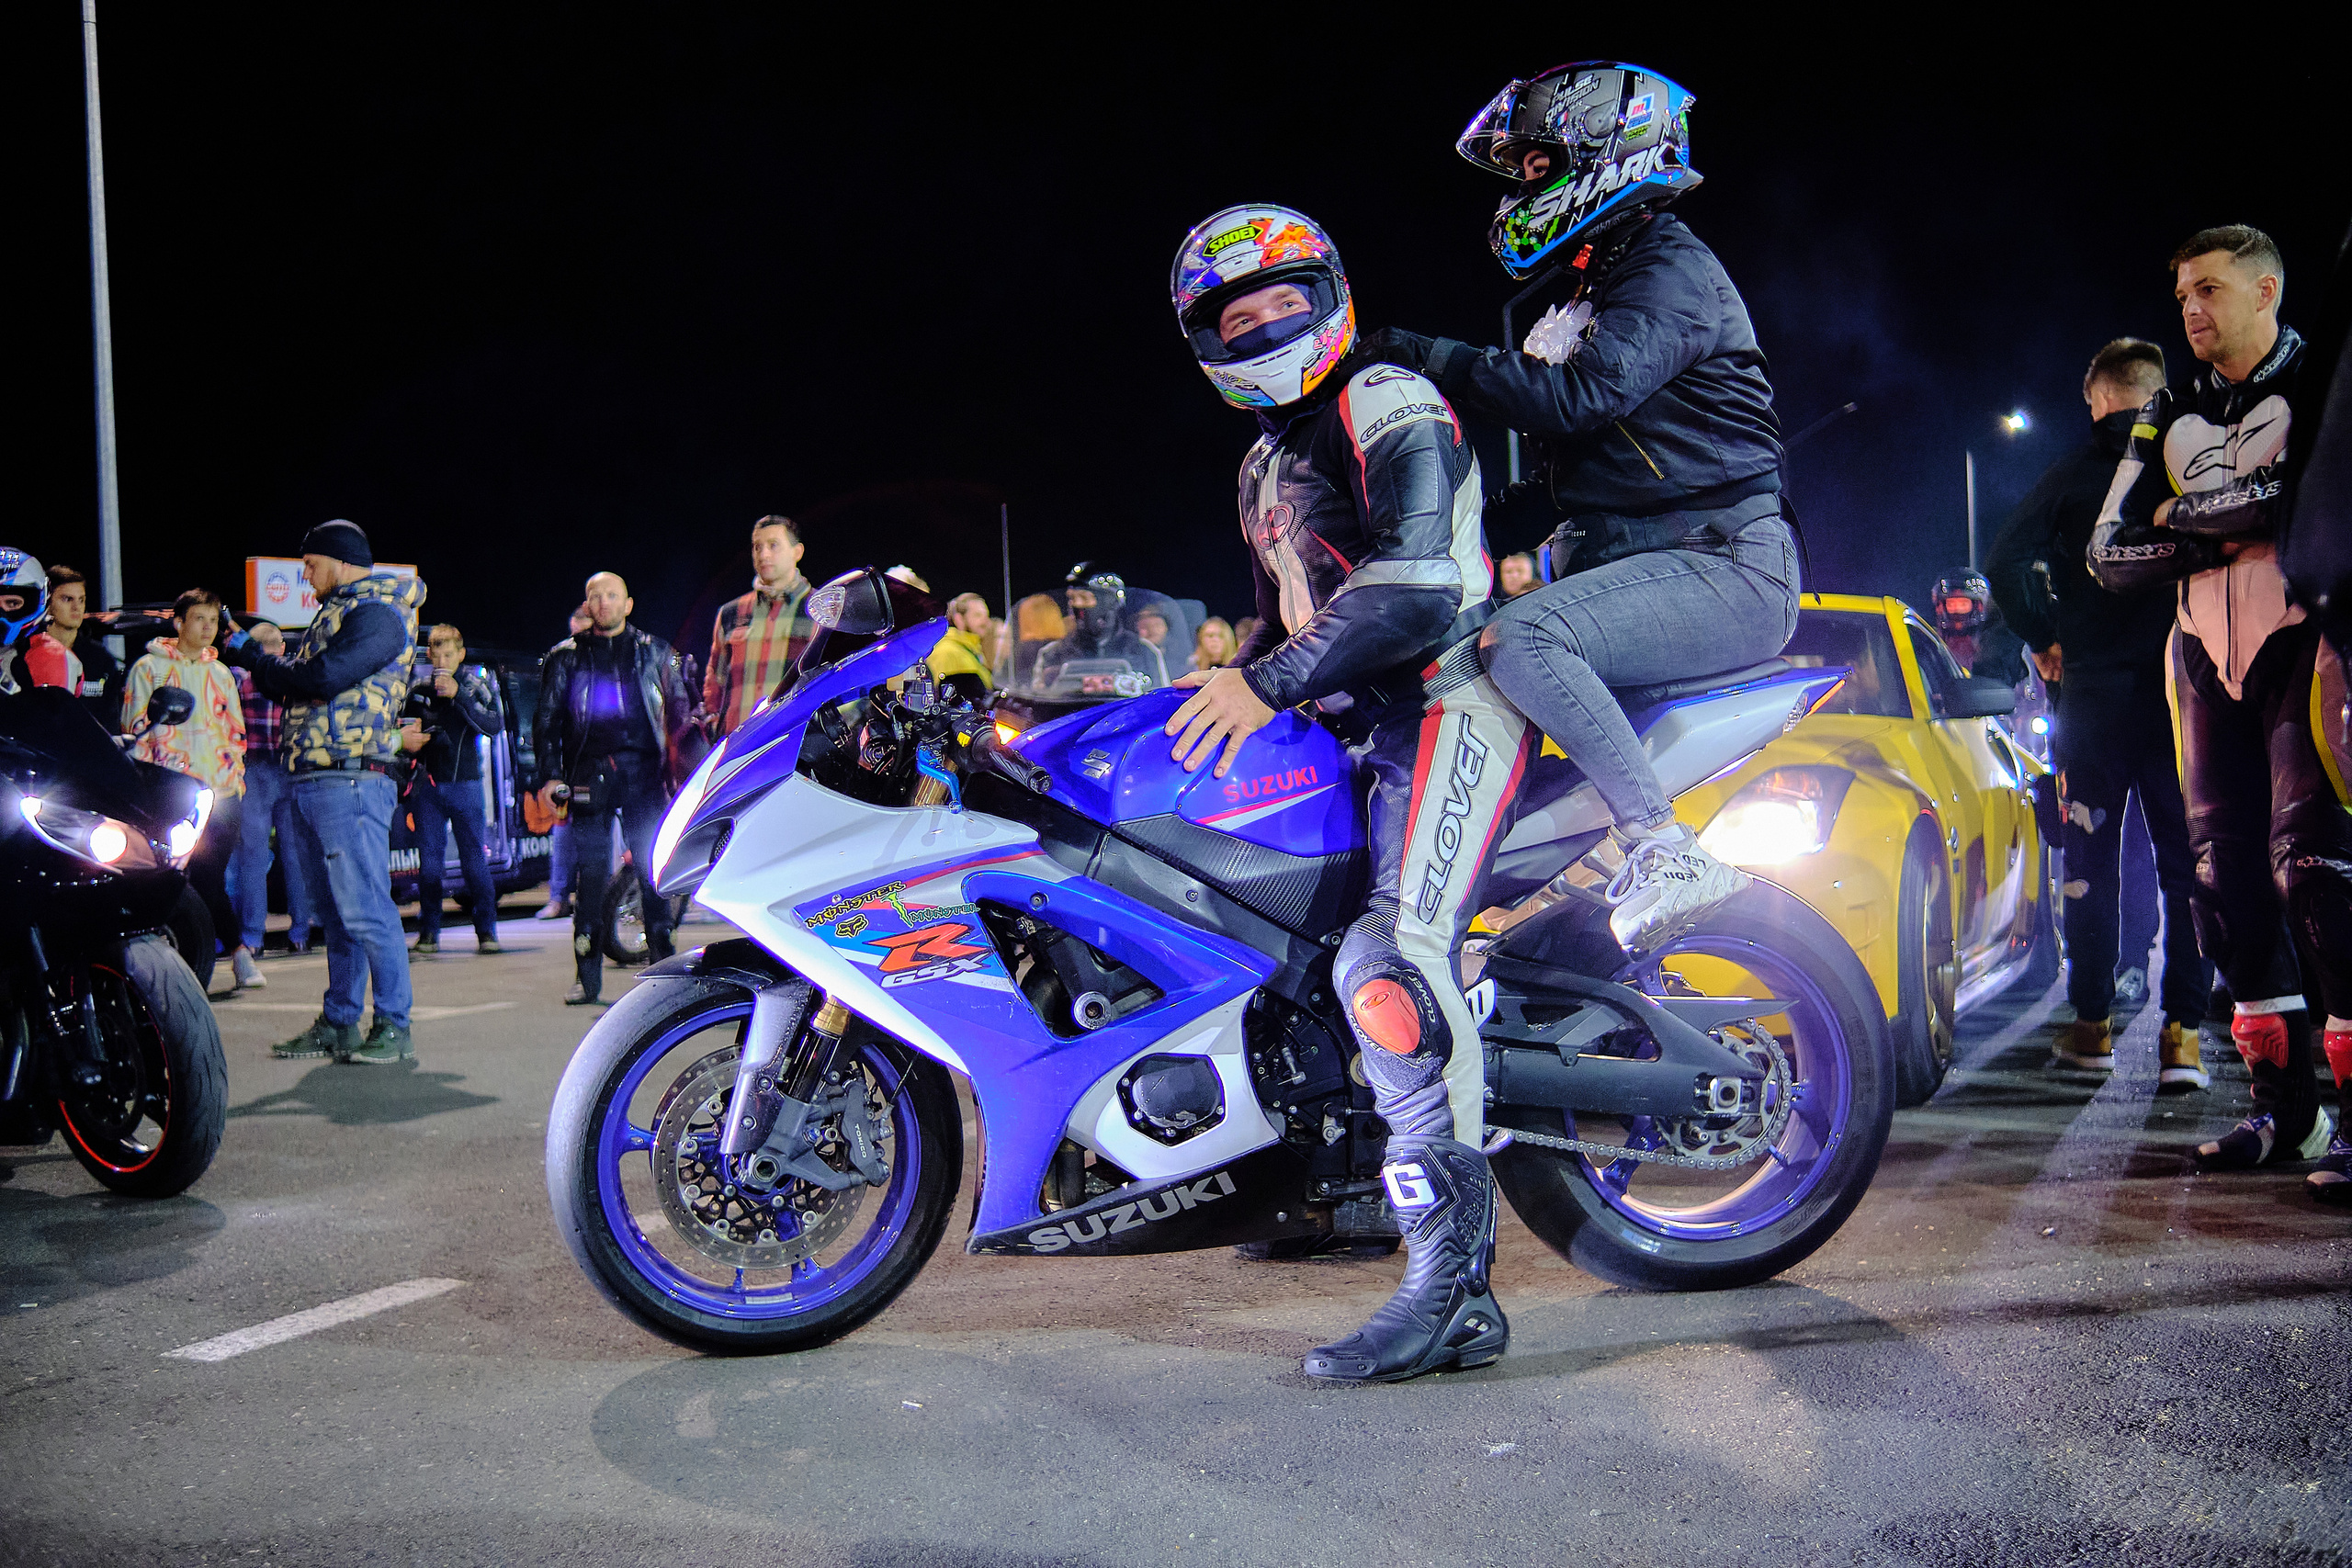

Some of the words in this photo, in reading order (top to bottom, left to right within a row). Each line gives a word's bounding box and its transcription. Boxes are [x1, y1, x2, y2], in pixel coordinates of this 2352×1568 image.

[1526, 142, 1670, 230] SHARK
[1208, 225, 1256, 254] SHOEI
[1360, 403, 1448, 443] CLOVER
[1223, 765, 1318, 803] SUZUKI
[1416, 710, 1490, 924] CLOVER
[804, 881, 906, 930] MONSTER
[909, 903, 980, 922] MONSTER
[863, 922, 991, 973] R
[880, 952, 990, 988] GSX
[1349, 1013, 1385, 1053] CLOVER
[854, 1123, 867, 1158] TOKICO
[1382, 1161, 1436, 1207] G
[1028, 1170, 1237, 1253] SUZUKI
